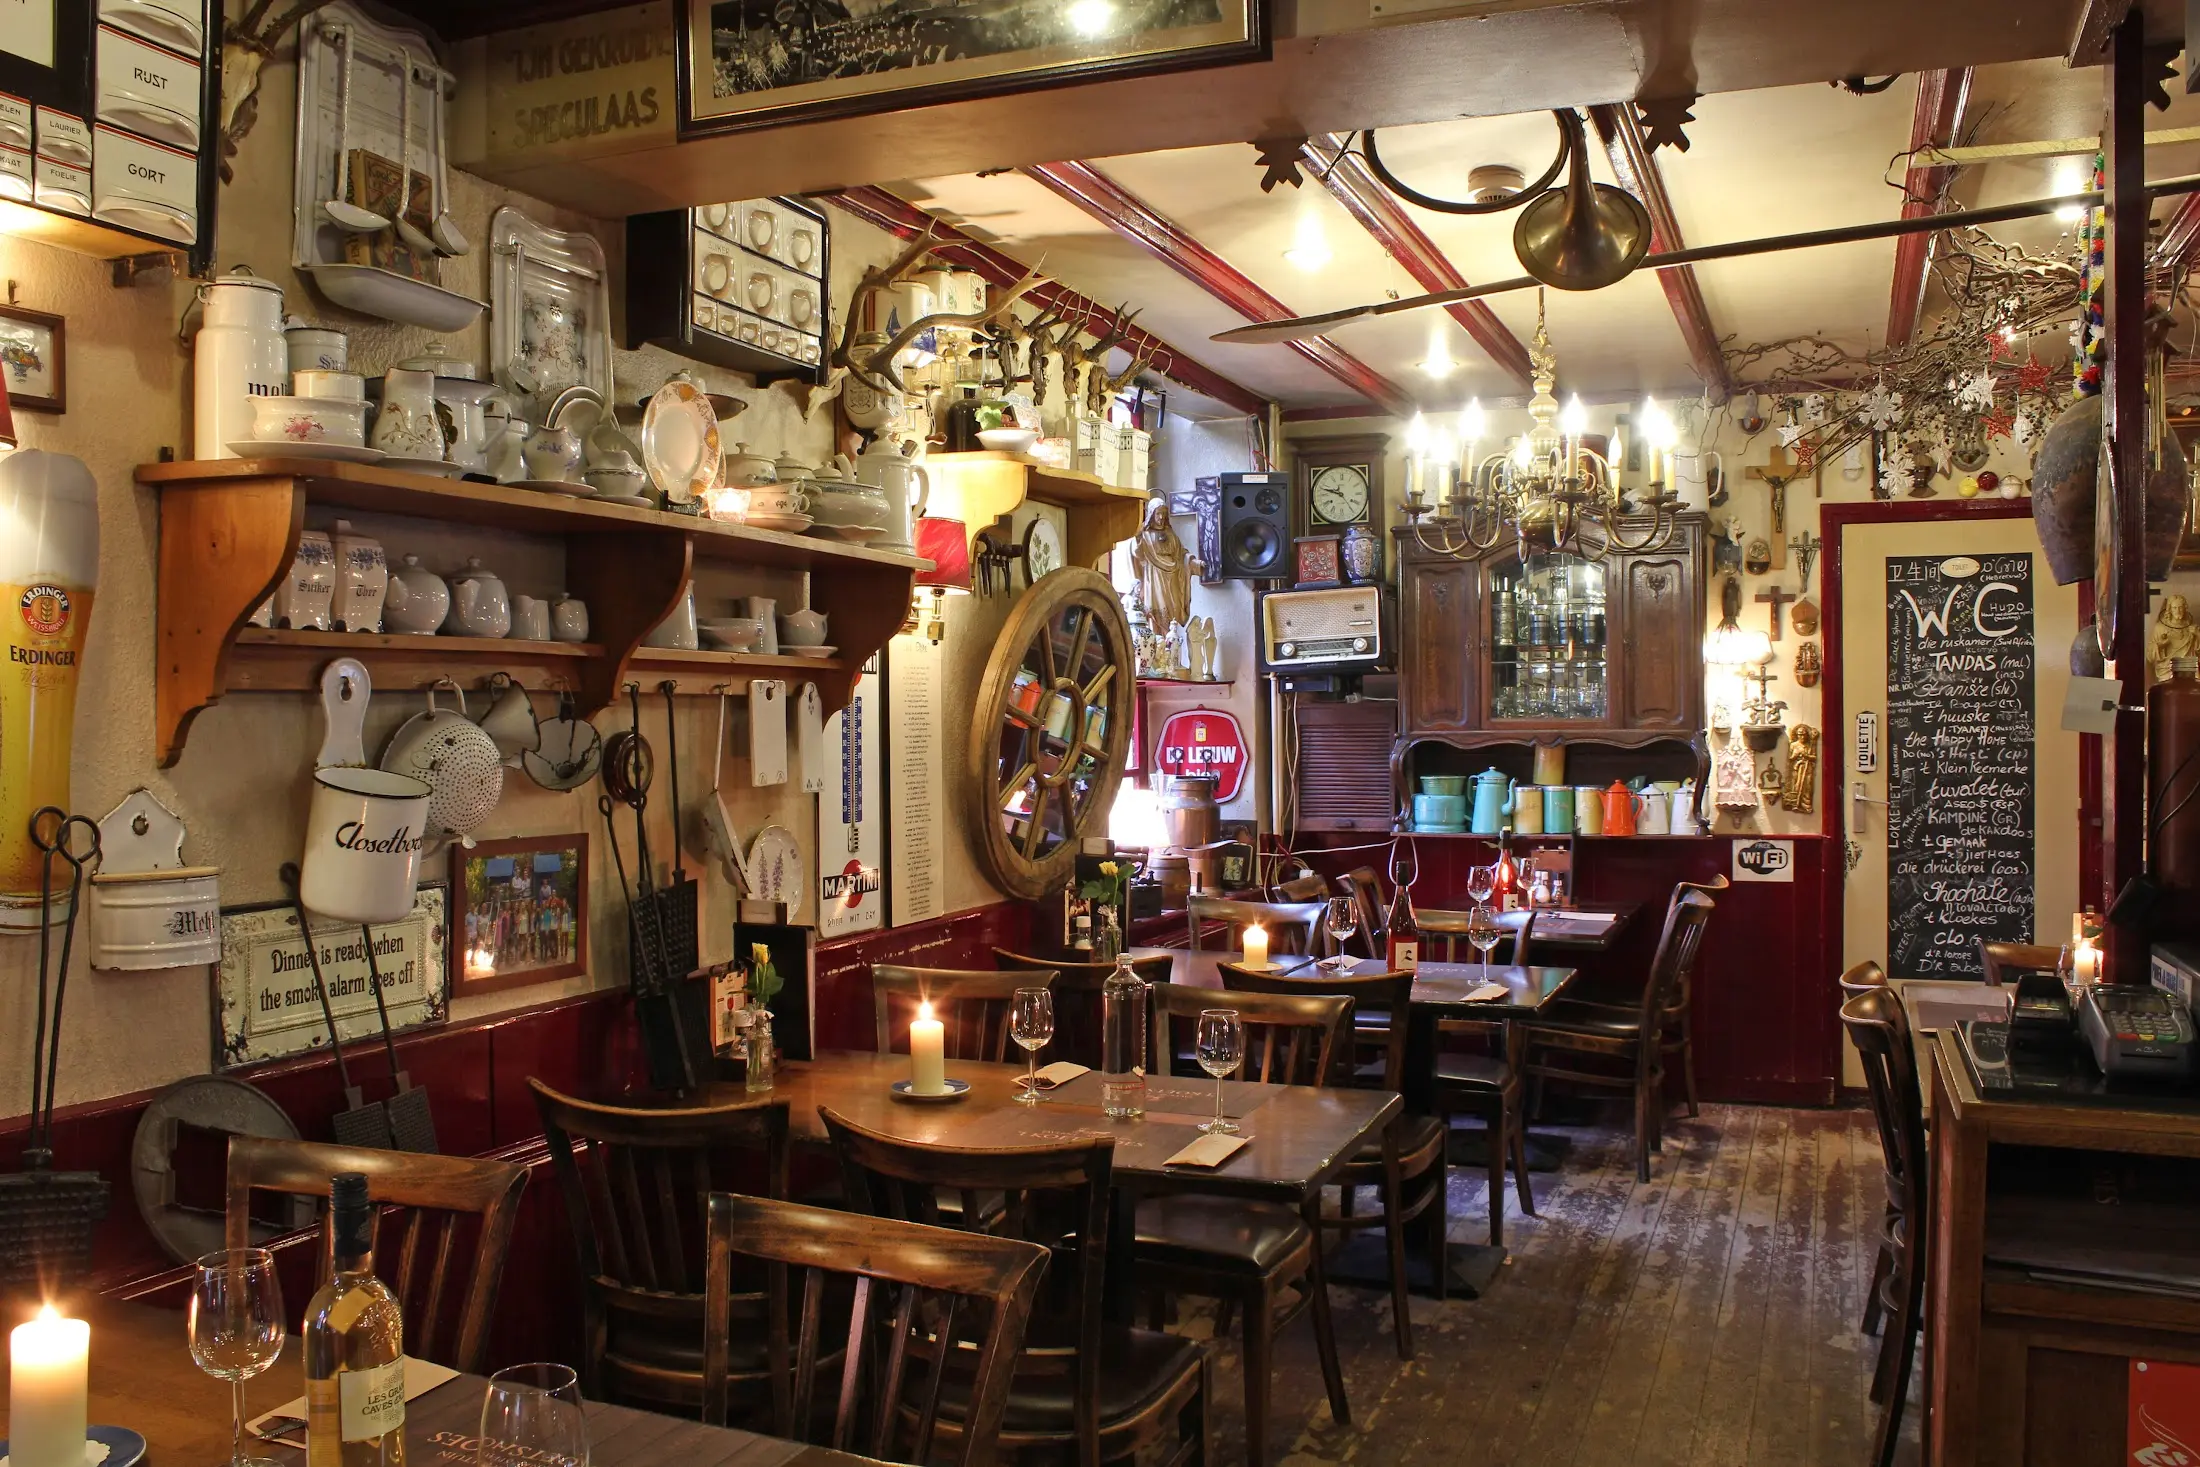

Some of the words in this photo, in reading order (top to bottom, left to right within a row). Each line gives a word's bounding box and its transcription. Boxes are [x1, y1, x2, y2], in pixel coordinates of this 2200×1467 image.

[512, 85, 659, 149] SPECULAAS
[49, 120, 81, 136] LAURIER
[50, 169, 77, 182] FOELIE
[127, 163, 166, 185] GORT
[23, 587, 68, 608] ERDINGER
[1918, 637, 1937, 650] die
[10, 644, 76, 666] ERDINGER
[1929, 651, 1997, 672] TANDAS
[1902, 682, 1914, 691] 100
[1937, 709, 1991, 722] huuske
[1858, 718, 1868, 767] TOILETTE
[1904, 731, 1927, 748] the
[1166, 746, 1183, 763] DE
[1188, 746, 1236, 763] LEEUW
[1936, 760, 1967, 774] Klein
[1926, 775, 1999, 800] tuvalet
[1960, 825, 1977, 836] de
[1897, 861, 1918, 874] die
[1923, 859, 1985, 874] drückerei
[825, 872, 877, 898] MARTINI
[850, 913, 860, 923] WIT
[865, 910, 876, 920] DRY
[271, 949, 315, 974] Dinne
[321, 944, 331, 965] is
[335, 936, 370, 963] ready
[373, 932, 404, 956] when
[260, 987, 281, 1012] the
[285, 979, 321, 1006] smok
[329, 974, 365, 997] alarm
[398, 961, 415, 984] off
[368, 1392, 386, 1405] LES
[361, 1400, 393, 1416] CAVES
